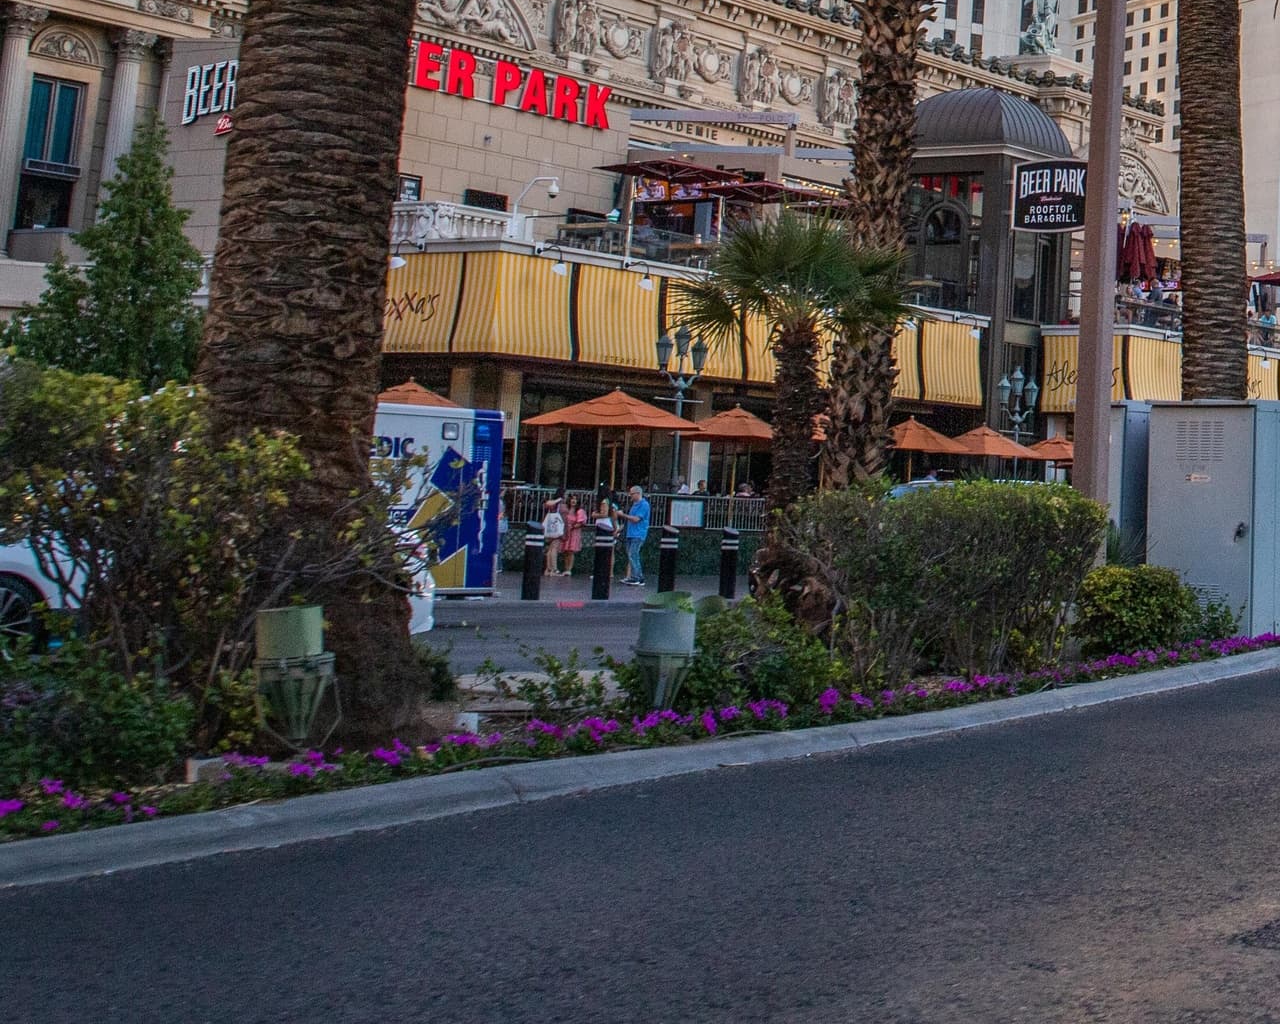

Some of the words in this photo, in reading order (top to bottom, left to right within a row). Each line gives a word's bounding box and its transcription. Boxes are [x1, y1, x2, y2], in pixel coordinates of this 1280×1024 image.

[181, 59, 239, 125] BEER
[408, 38, 477, 99] ER
[489, 59, 613, 130] PARK
[1019, 168, 1051, 199] BEER
[1054, 168, 1086, 197] PARK
[1029, 204, 1073, 215] ROOFTOP
